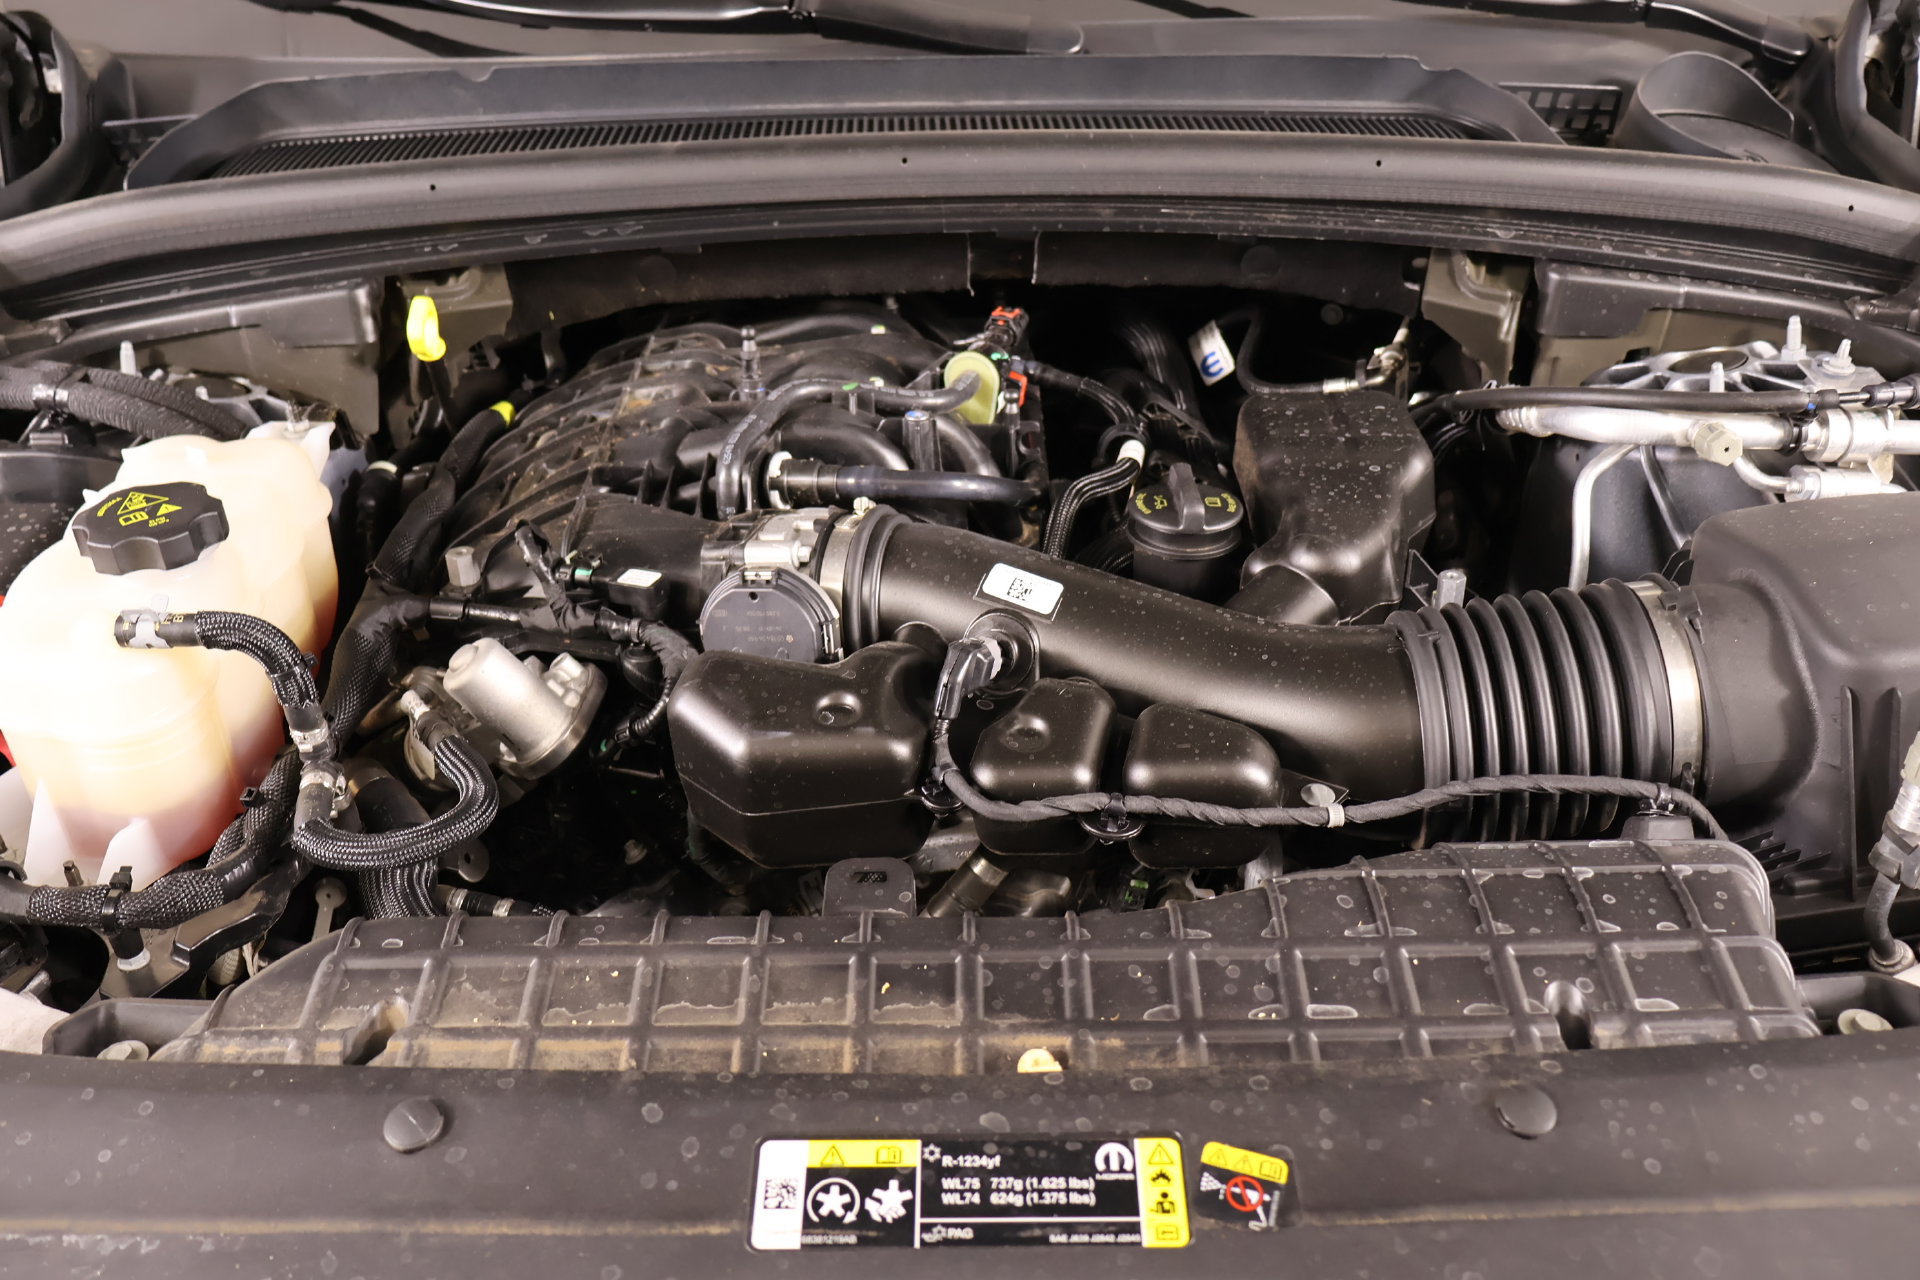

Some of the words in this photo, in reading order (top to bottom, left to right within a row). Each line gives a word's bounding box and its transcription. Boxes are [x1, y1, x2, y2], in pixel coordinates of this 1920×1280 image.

[941, 1155, 1001, 1169] R-1234yf
[941, 1177, 981, 1190] WL75
[990, 1177, 1024, 1192] 737g
[941, 1191, 981, 1205] WL74
[990, 1191, 1024, 1207] 624g
[947, 1227, 974, 1239] PAG
